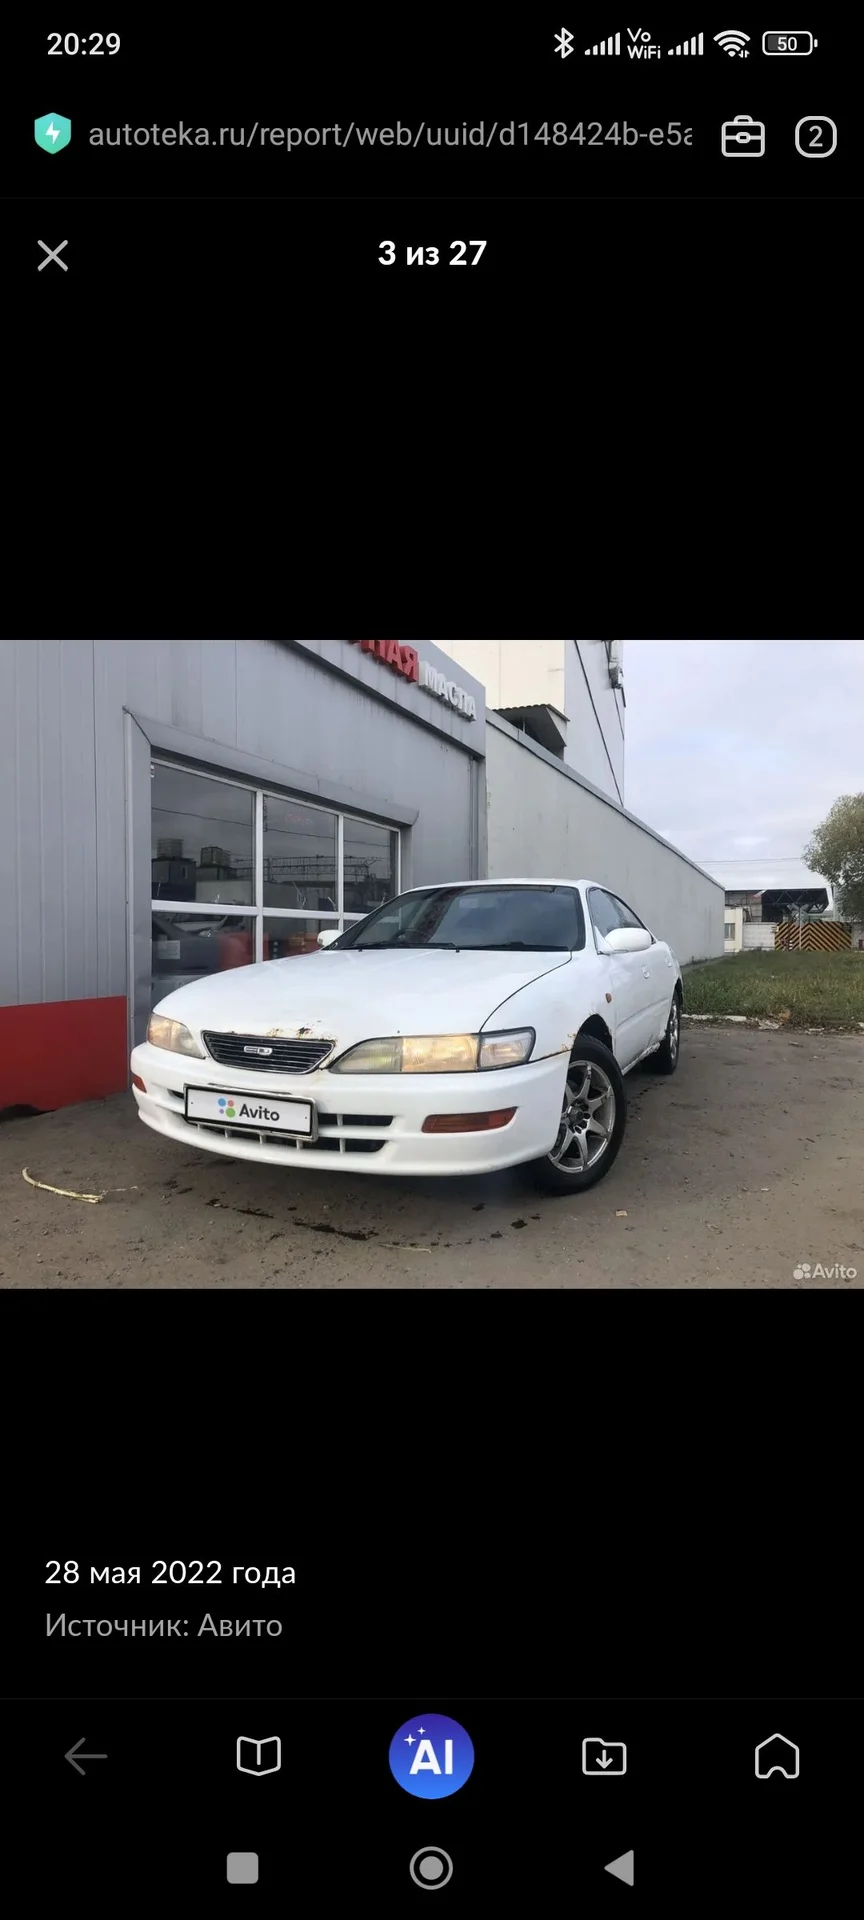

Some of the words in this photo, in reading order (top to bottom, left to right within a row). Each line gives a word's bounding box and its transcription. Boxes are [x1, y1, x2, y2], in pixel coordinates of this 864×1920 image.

[47, 33, 121, 55] 20:29
[627, 28, 651, 42] Vo
[777, 37, 797, 51] 50
[627, 45, 661, 59] WiFi
[809, 126, 823, 147] 2
[378, 241, 396, 265] 3
[406, 247, 440, 265] из
[449, 241, 488, 265] 27
[45, 1561, 80, 1583] 28
[90, 1567, 141, 1583] мая
[151, 1561, 223, 1583] 2022
[233, 1567, 296, 1588] года
[46, 1613, 189, 1637] Источник:
[197, 1613, 283, 1637] Авито
[409, 1739, 453, 1775] AI
